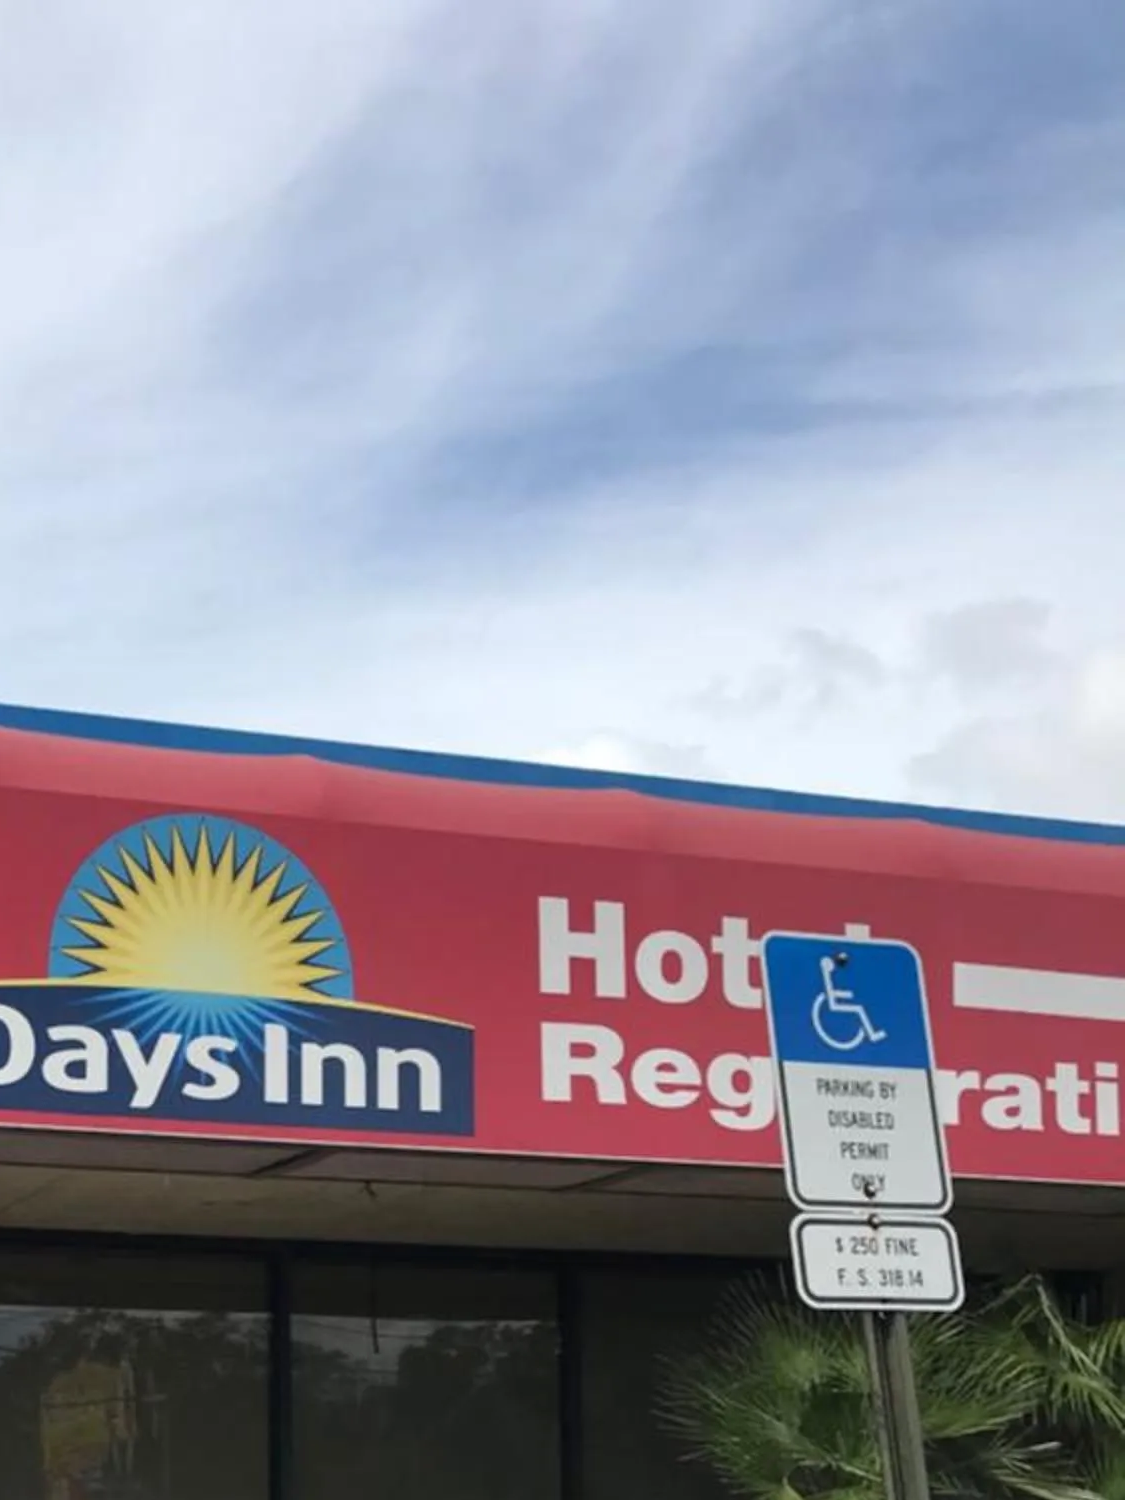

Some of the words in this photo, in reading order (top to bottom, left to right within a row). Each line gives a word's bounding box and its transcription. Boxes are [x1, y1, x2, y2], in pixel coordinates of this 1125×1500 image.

[538, 895, 871, 1010] Hot
[263, 1023, 442, 1113] Inn
[539, 1021, 1121, 1137] Regrati
[816, 1077, 875, 1100] PARKING
[878, 1081, 897, 1101] BY
[828, 1109, 895, 1130] DISABLED
[840, 1140, 890, 1161] PERMIT
[849, 1236, 879, 1256] 250
[884, 1237, 920, 1257] FINE
